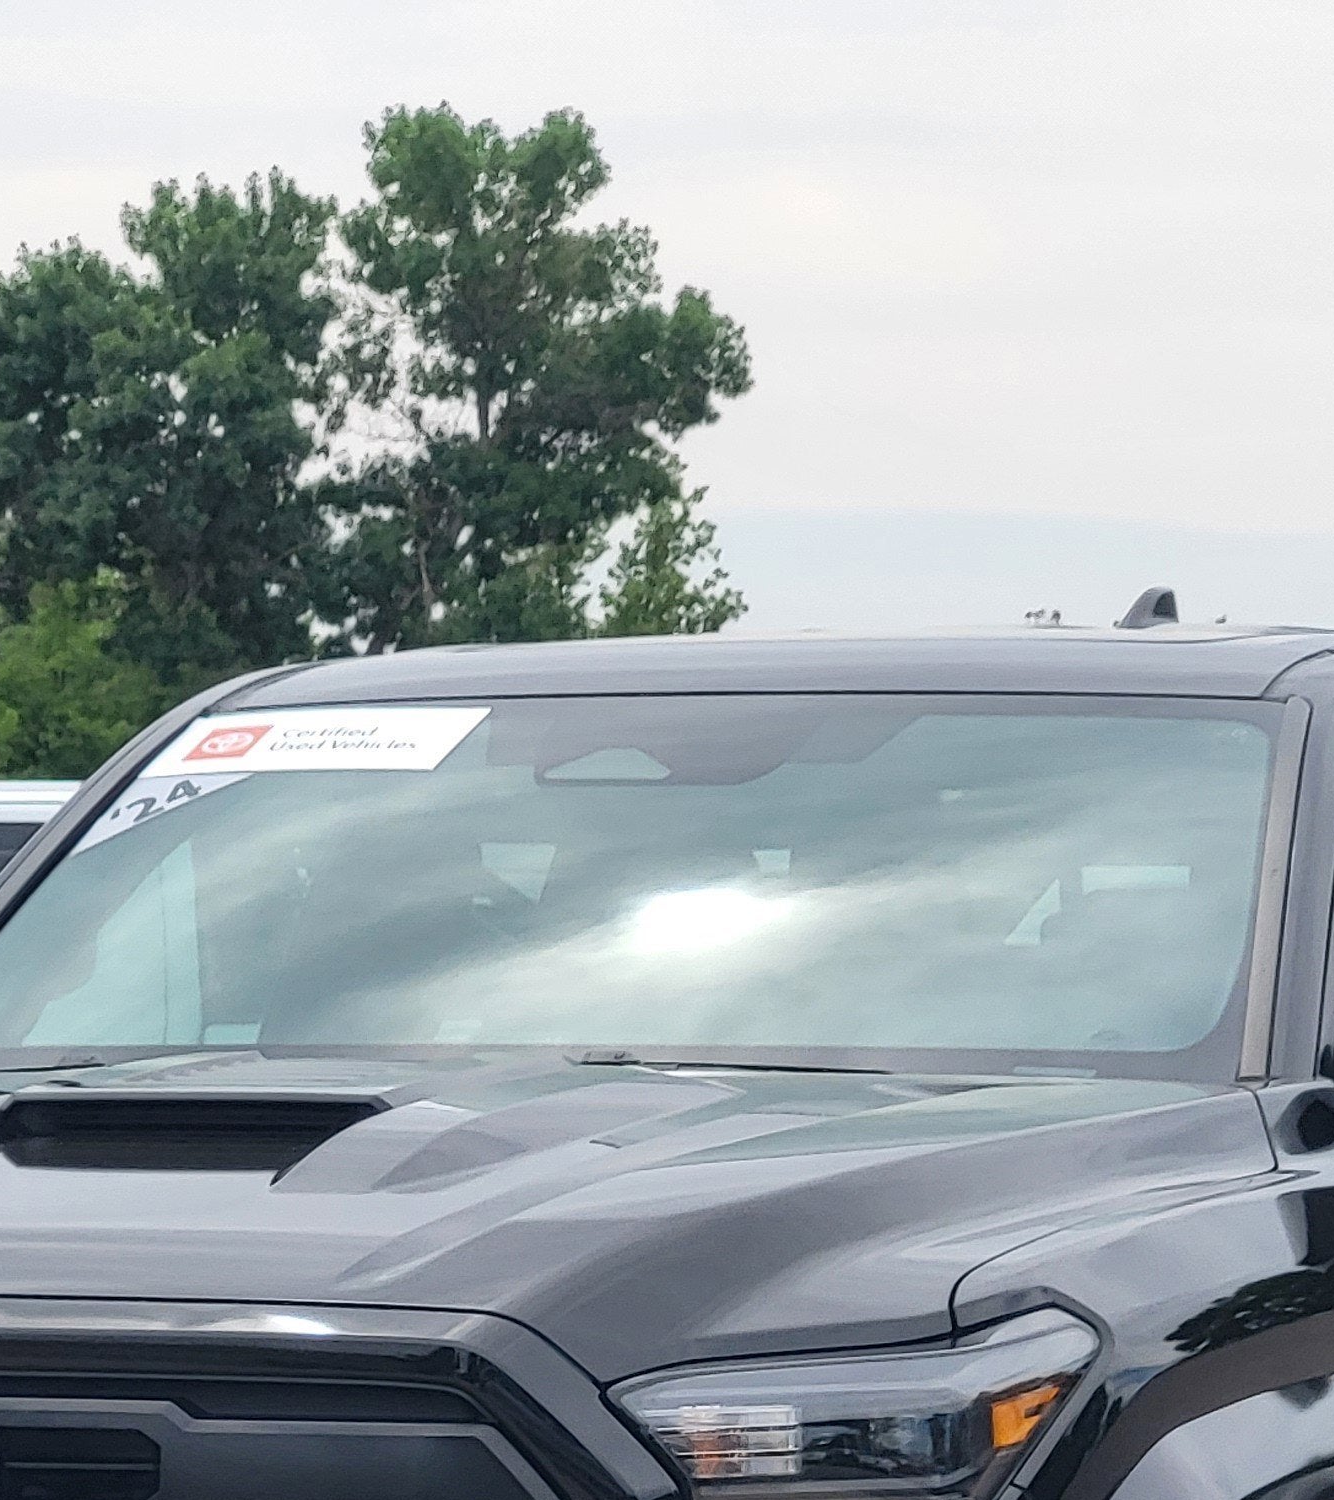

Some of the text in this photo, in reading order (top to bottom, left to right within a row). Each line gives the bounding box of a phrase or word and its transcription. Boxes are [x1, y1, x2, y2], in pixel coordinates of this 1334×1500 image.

[283, 726, 379, 738] Certified
[270, 739, 416, 751] Used Vehicles
